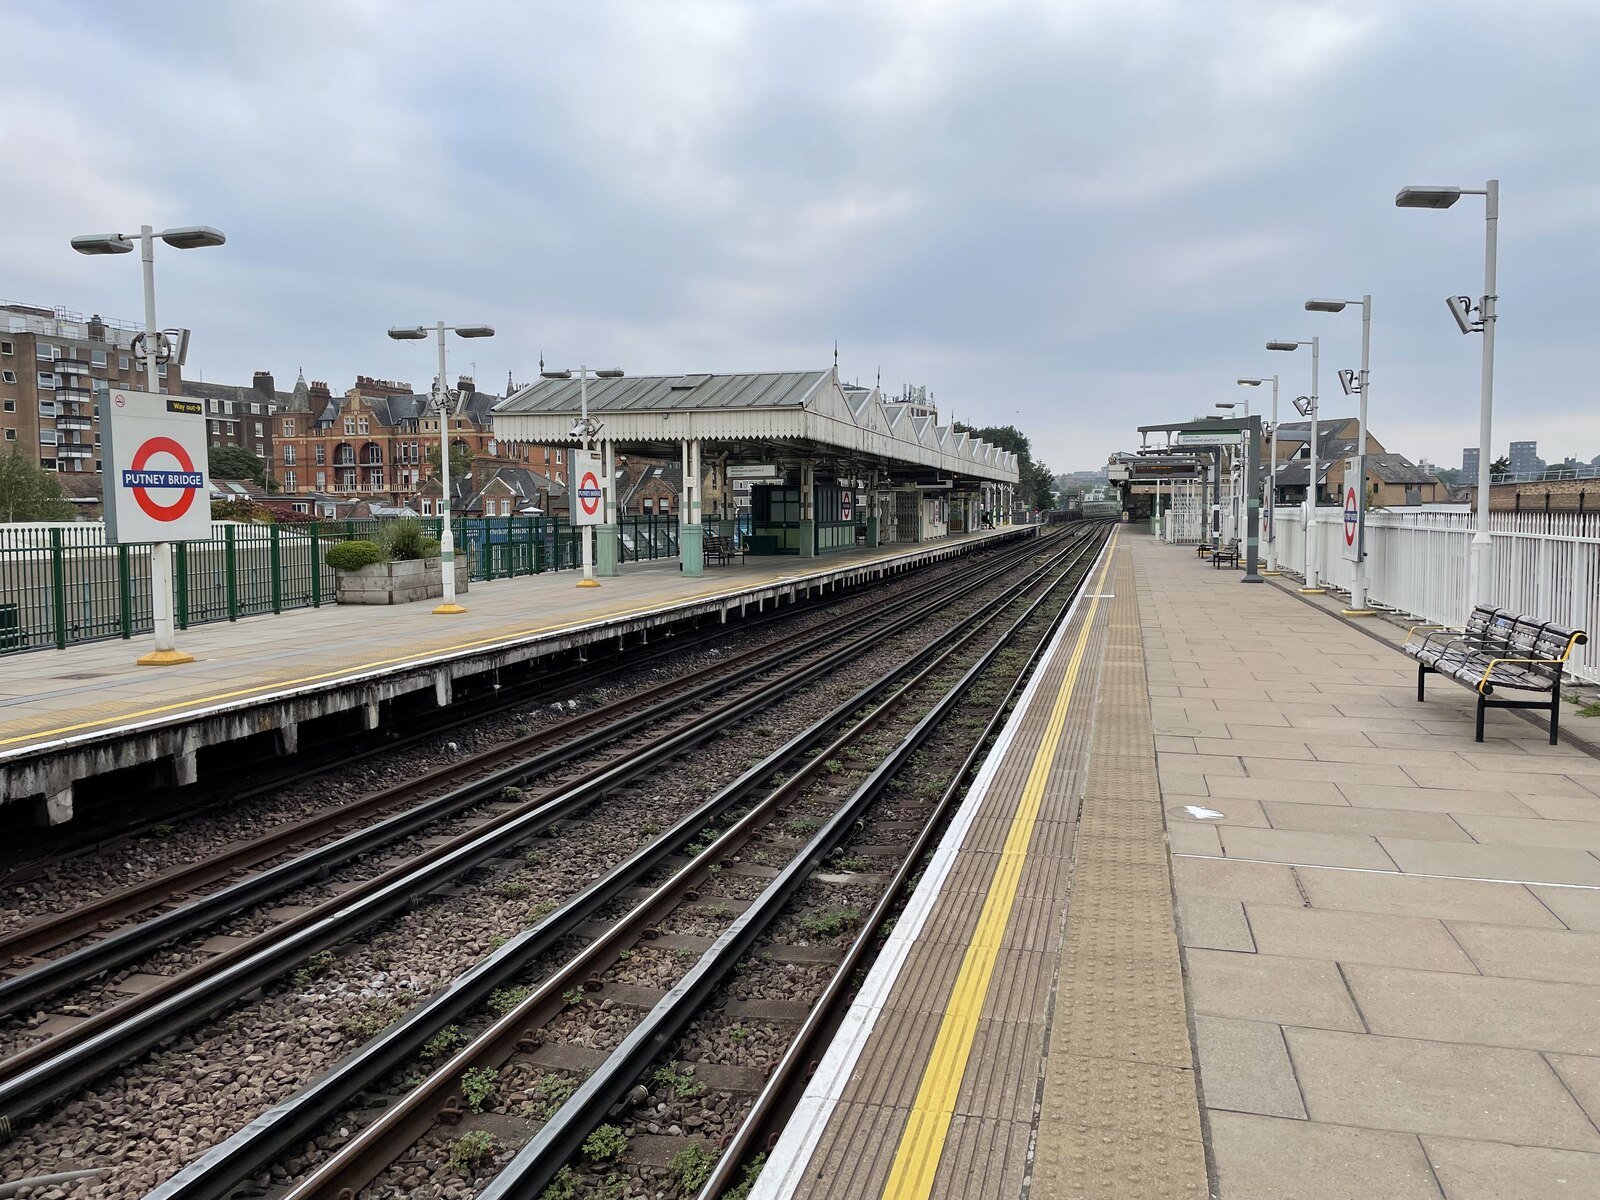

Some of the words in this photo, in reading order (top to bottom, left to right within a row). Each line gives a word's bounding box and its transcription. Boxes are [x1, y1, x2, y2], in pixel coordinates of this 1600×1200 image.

[173, 402, 185, 411] Way
[125, 473, 165, 485] PUTNEY
[168, 475, 201, 485] BRIDGE
